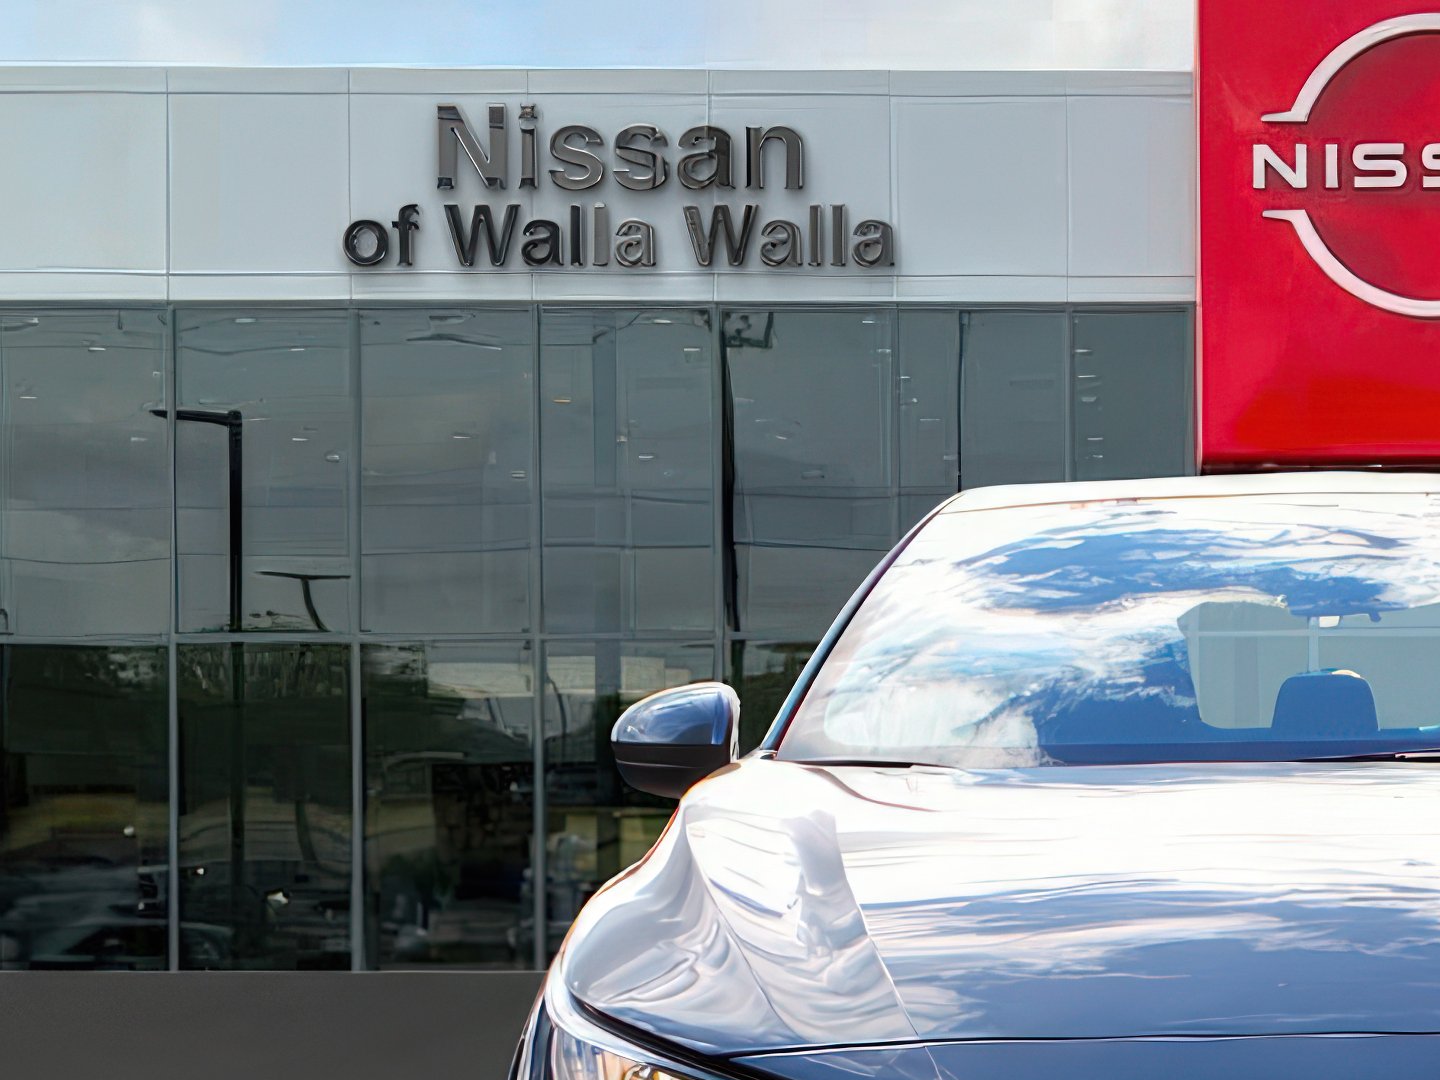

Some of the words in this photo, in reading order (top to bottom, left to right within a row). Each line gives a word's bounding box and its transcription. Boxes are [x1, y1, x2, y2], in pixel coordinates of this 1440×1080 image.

[436, 103, 803, 190] Nissan
[342, 204, 420, 267] of
[444, 203, 657, 267] Walla
[683, 203, 896, 267] Walla
